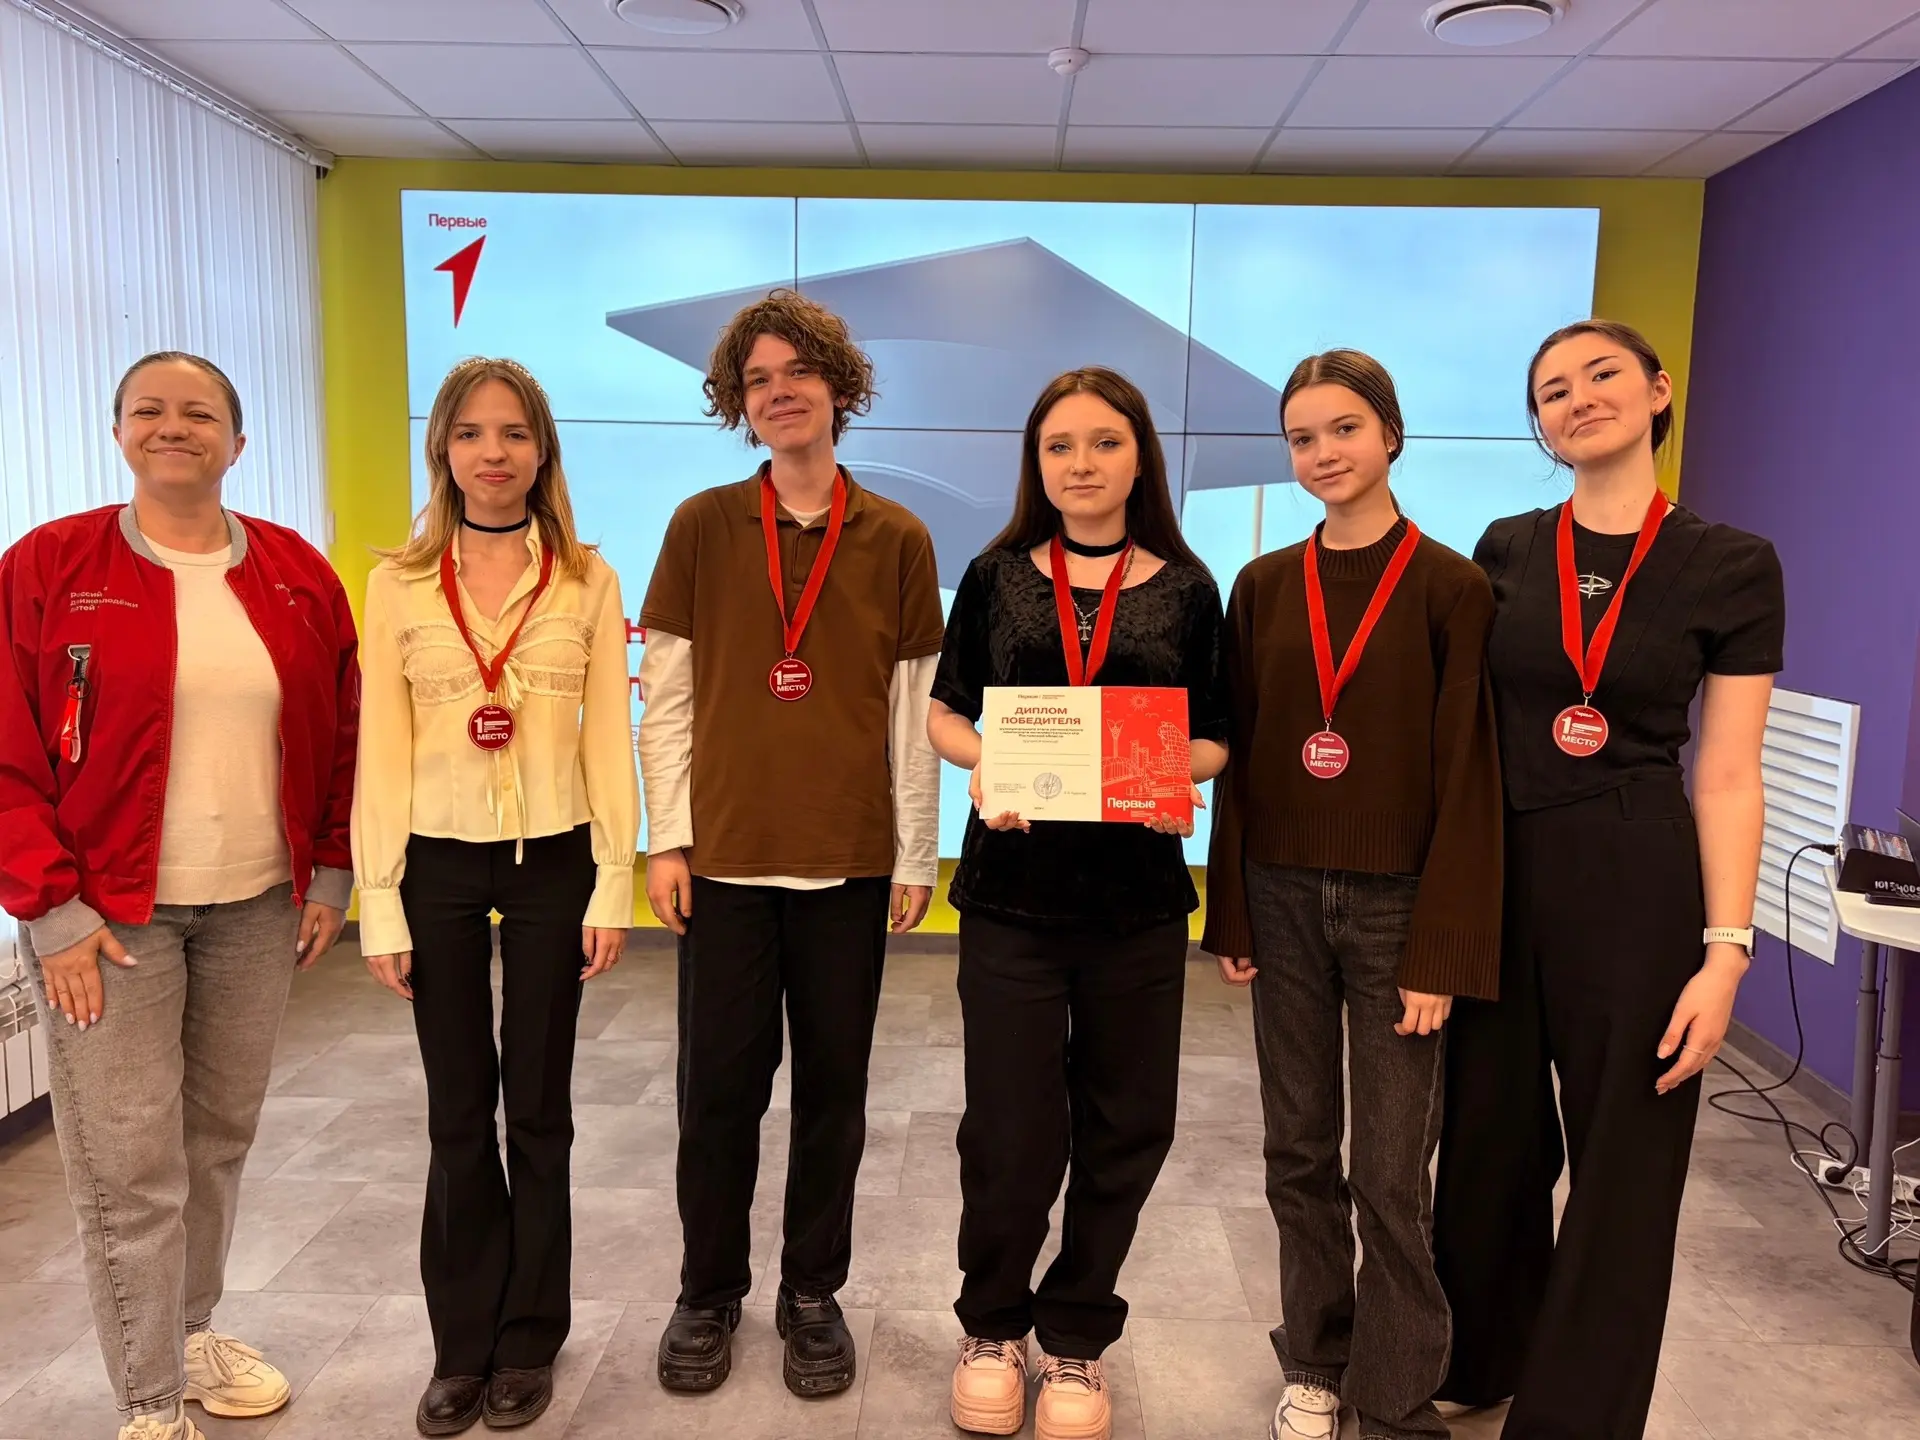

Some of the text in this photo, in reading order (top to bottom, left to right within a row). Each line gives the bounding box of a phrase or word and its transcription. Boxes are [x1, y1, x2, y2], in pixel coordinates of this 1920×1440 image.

[428, 213, 487, 231] Первые
[776, 684, 806, 692] МЕСТО
[1014, 706, 1068, 715] ДИПЛОМ
[1001, 716, 1081, 726] ПОБЕДИТЕЛЯ
[476, 732, 509, 741] МЕСТО
[1560, 734, 1598, 747] МЕСТО
[1309, 759, 1341, 769] МЕСТО
[1107, 797, 1156, 812] Первые
